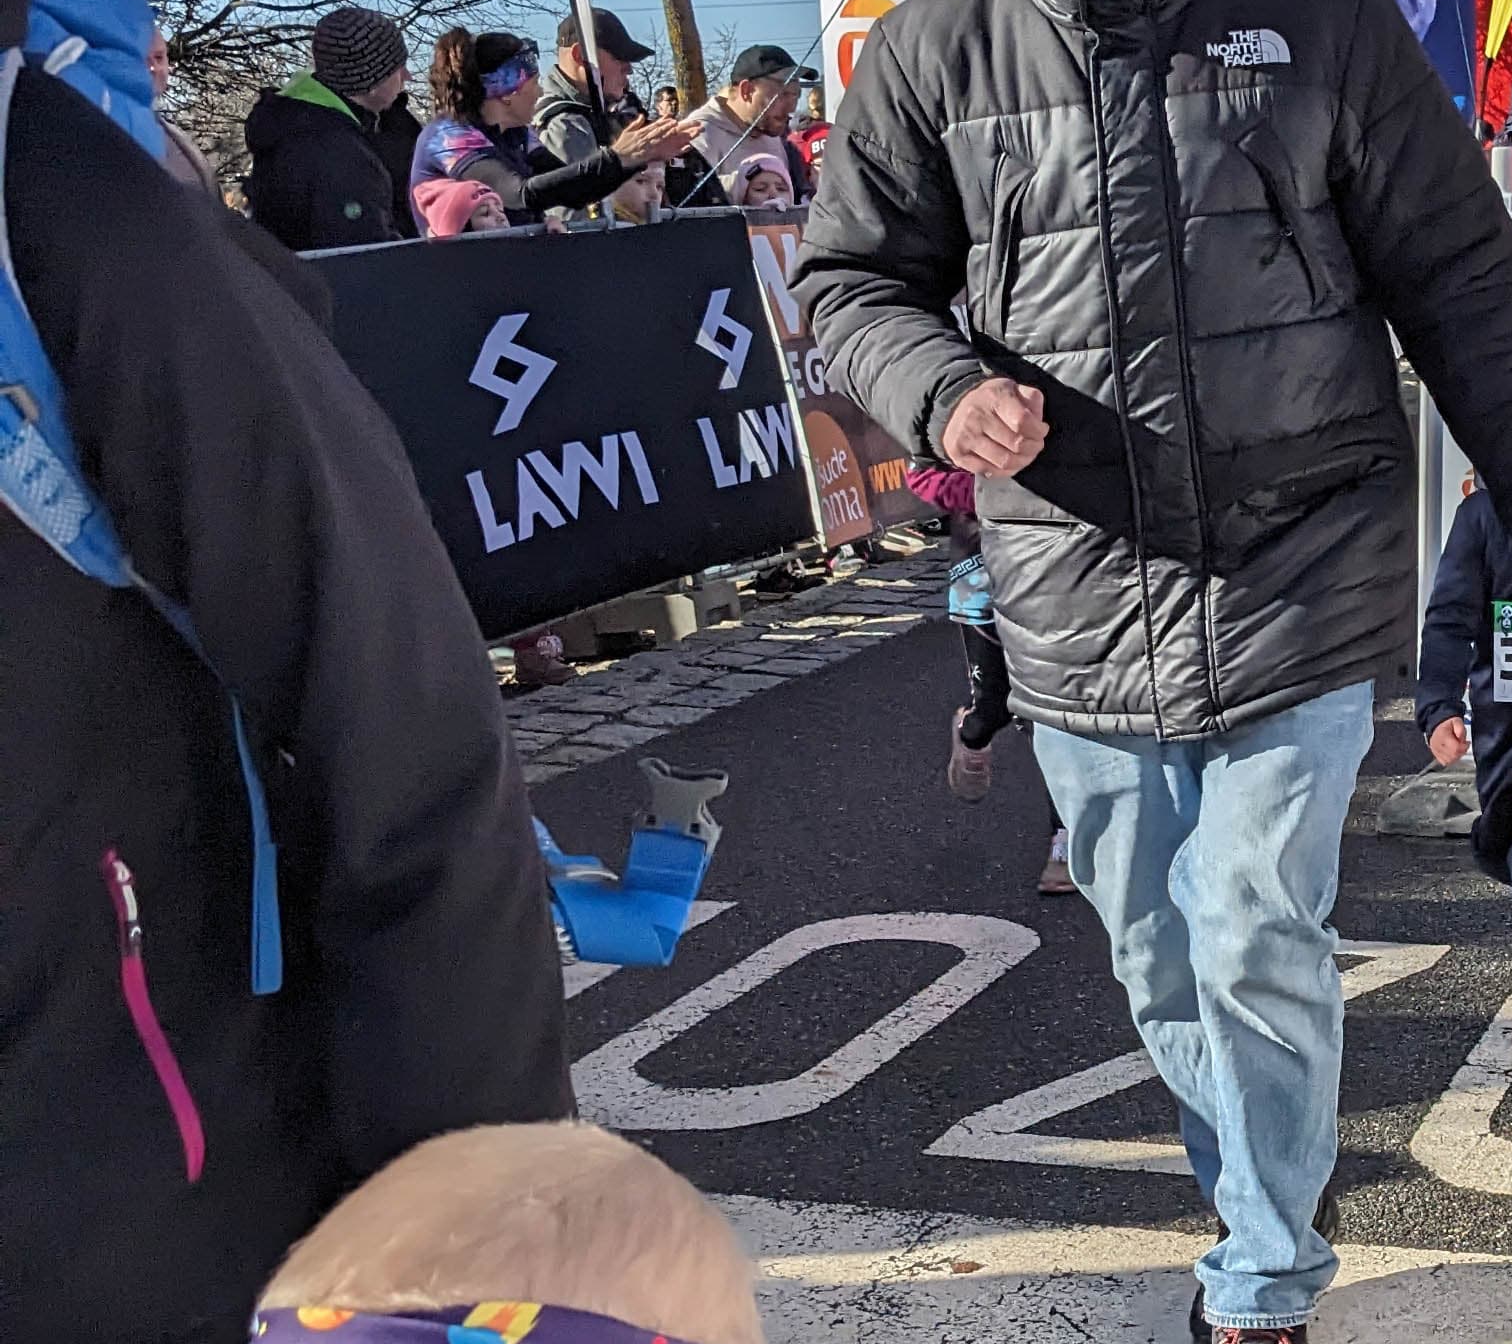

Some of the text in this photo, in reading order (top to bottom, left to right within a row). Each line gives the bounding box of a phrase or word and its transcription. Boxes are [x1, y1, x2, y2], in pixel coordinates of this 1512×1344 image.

[1228, 29, 1260, 44] THE
[1206, 41, 1262, 58] NORTH
[1223, 53, 1263, 68] FACE
[696, 402, 797, 489] LAW
[465, 430, 660, 554] LAWI
